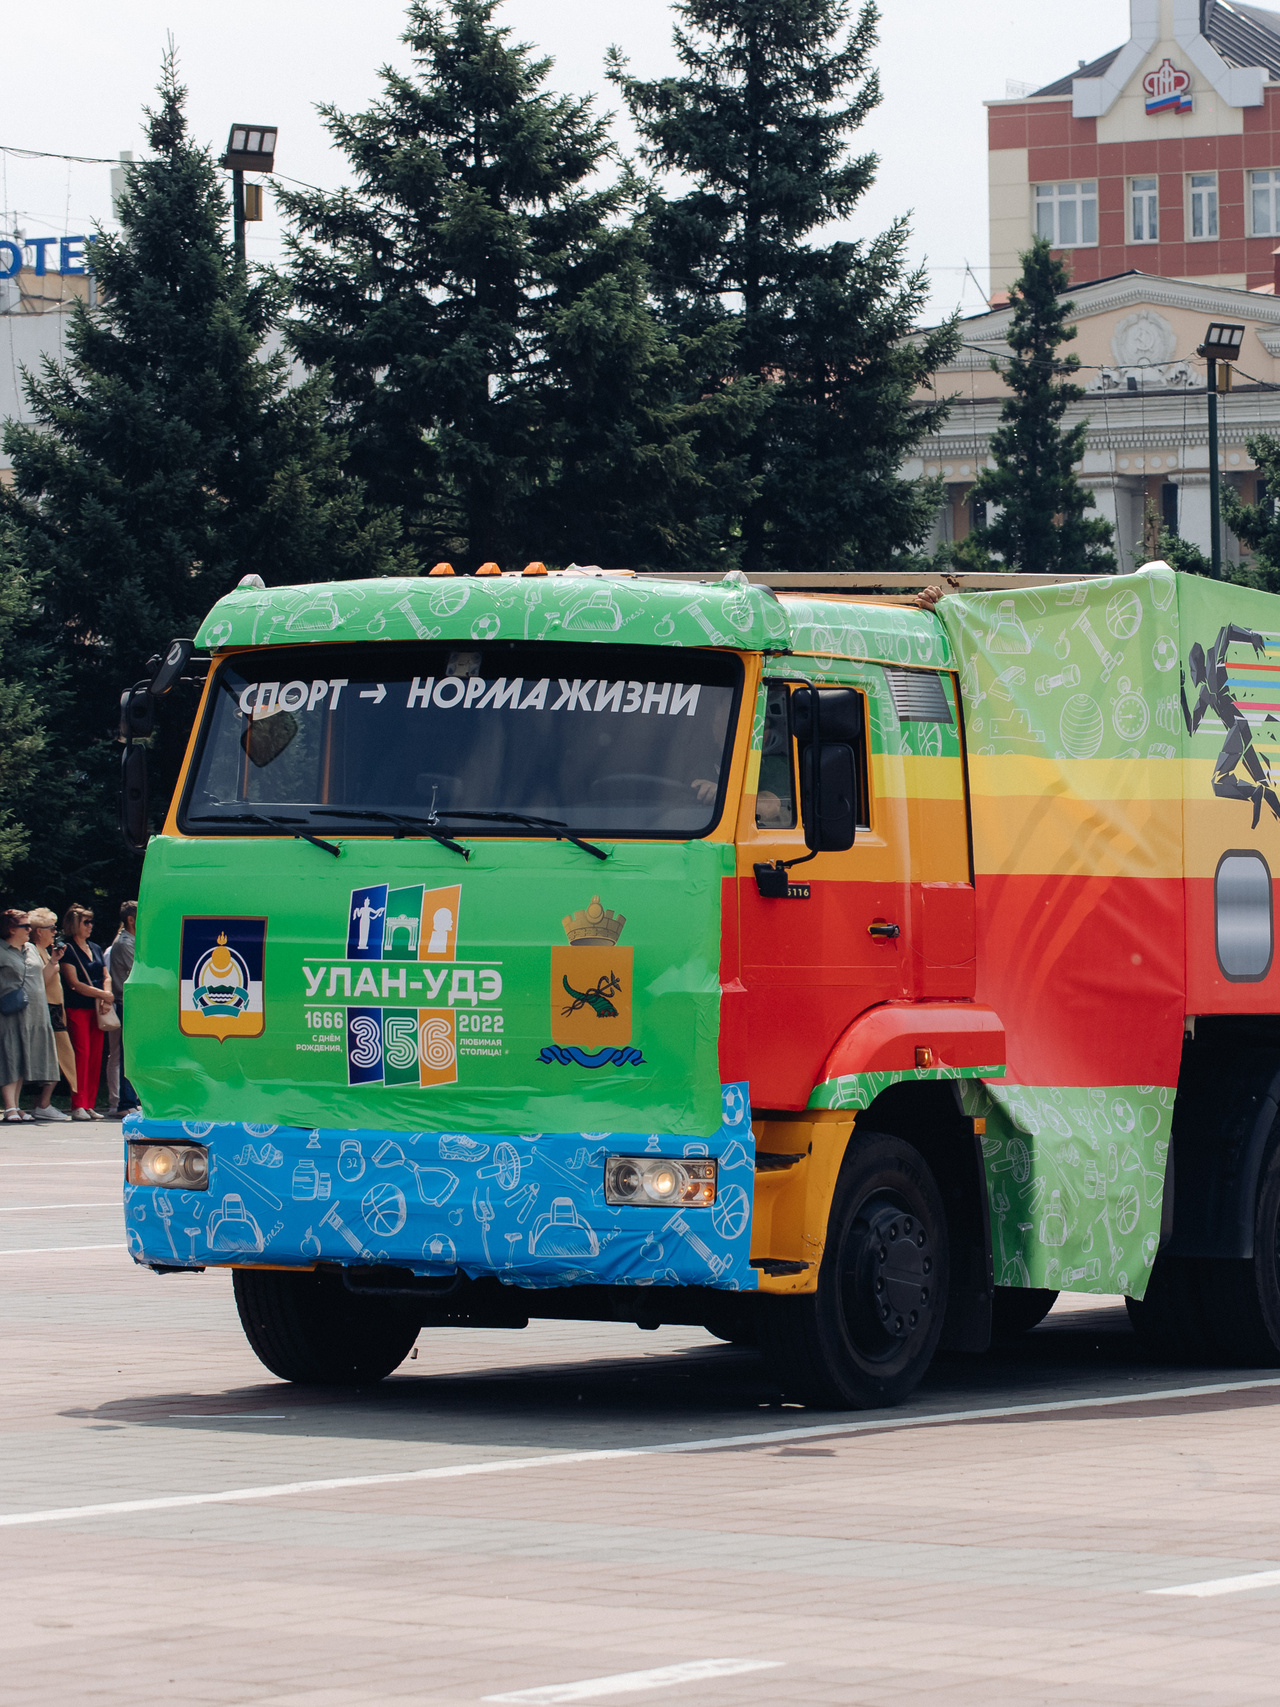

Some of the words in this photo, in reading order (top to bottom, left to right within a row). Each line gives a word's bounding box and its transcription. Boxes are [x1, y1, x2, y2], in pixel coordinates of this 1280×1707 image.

[0, 235, 98, 279] OTE
[239, 679, 349, 714] СПОРТ
[407, 676, 550, 710] НОРМА
[550, 678, 702, 716] ЖИЗНИ
[302, 966, 503, 1006] УЛАН-УДЭ
[304, 1011, 344, 1029] 1666
[458, 1014, 504, 1033] 2022
[318, 1033, 341, 1043] ДНЁМ
[350, 1015, 456, 1070] 356
[459, 1038, 502, 1046] ЛЮБИМАЯ
[295, 1043, 343, 1053] РОЖДЕНИЯ,
[459, 1047, 502, 1057] СТОЛИЦА!
